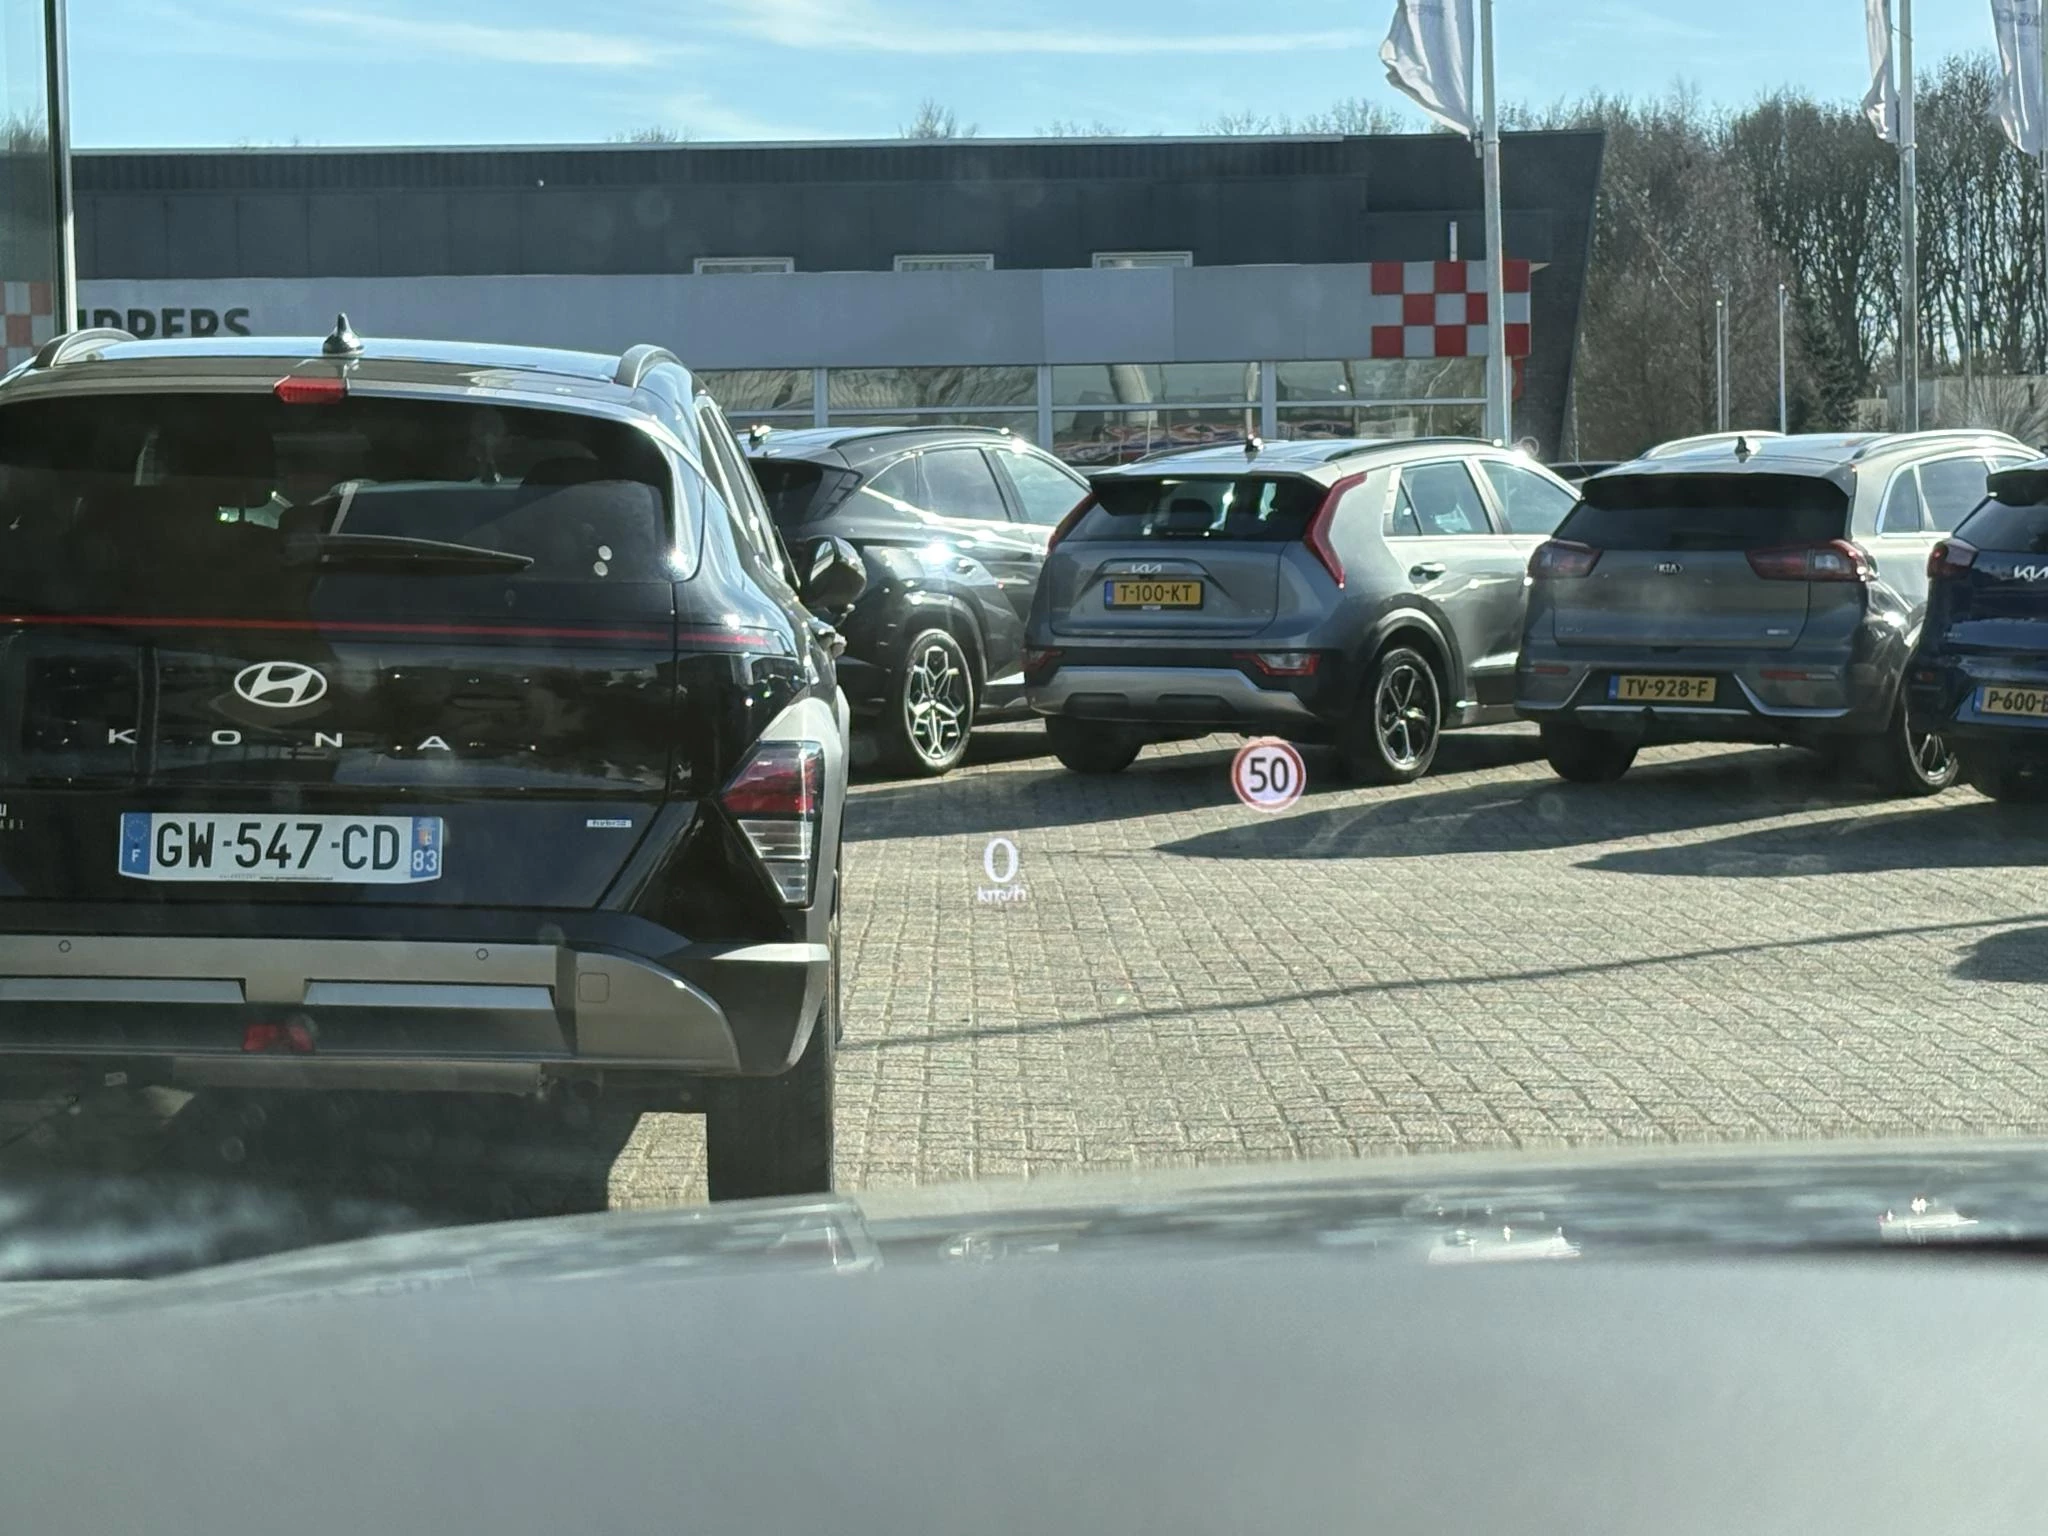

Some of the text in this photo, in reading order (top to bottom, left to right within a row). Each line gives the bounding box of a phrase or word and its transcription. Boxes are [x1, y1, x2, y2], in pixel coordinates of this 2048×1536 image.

[1120, 584, 1193, 602] T-100-KT
[1625, 678, 1709, 697] TV-928-F
[1249, 756, 1290, 793] 50
[131, 848, 142, 863] F
[156, 821, 400, 870] GW-547-CD
[412, 849, 438, 872] 83
[983, 837, 1019, 883] 0
[976, 884, 1028, 903] km/h
